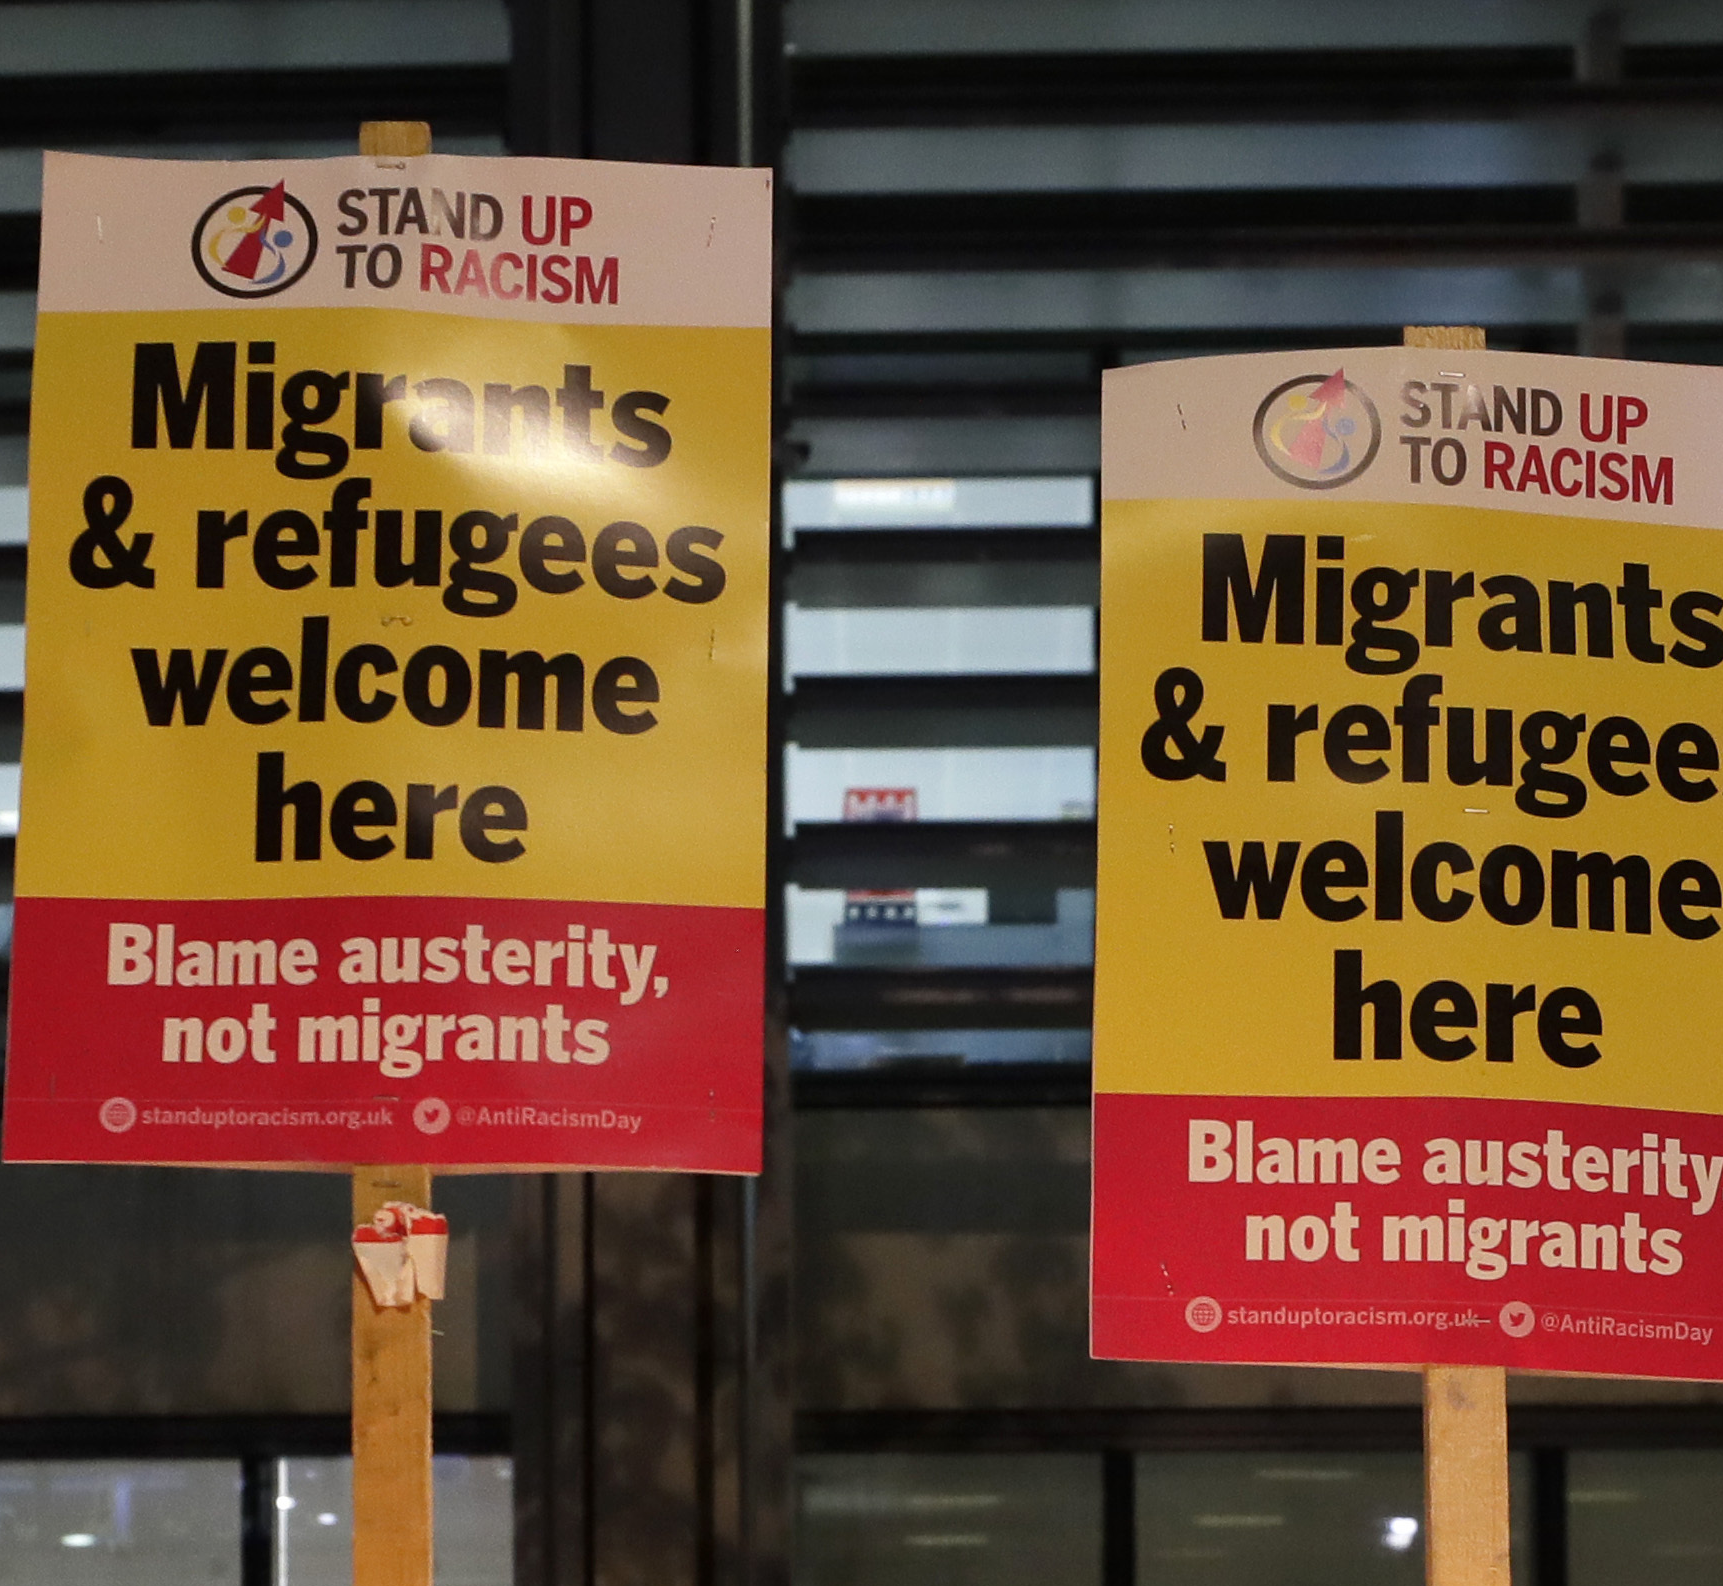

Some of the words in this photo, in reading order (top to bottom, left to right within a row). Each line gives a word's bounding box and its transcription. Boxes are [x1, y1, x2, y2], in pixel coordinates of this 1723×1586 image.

[336, 187, 503, 241] STAND
[521, 196, 592, 247] UP
[336, 244, 402, 289] TO
[419, 246, 619, 306] RACISM
[131, 341, 672, 479] Migrants
[1400, 380, 1563, 437] STAND
[1579, 394, 1647, 445] UP
[1400, 436, 1466, 485] TO
[1484, 440, 1674, 505] RACISM
[69, 475, 156, 589] &
[196, 478, 726, 617] refugees
[132, 616, 660, 734] welcome
[1140, 667, 1226, 782] &
[255, 752, 529, 863] here
[1202, 810, 1723, 940] welcome
[107, 922, 316, 987] Blame
[338, 925, 670, 1006] austerity,
[162, 1003, 275, 1064] not
[298, 998, 610, 1077] migrants
[1333, 949, 1603, 1068] here
[142, 1106, 393, 1130] standuptoracism.org.uk
[455, 1106, 641, 1135] @AntiRacismDay
[1188, 1118, 1402, 1185] Blame
[1245, 1202, 1360, 1262] not
[1382, 1200, 1683, 1280] migrants
[1540, 1311, 1713, 1346] @AntiRacismDay
